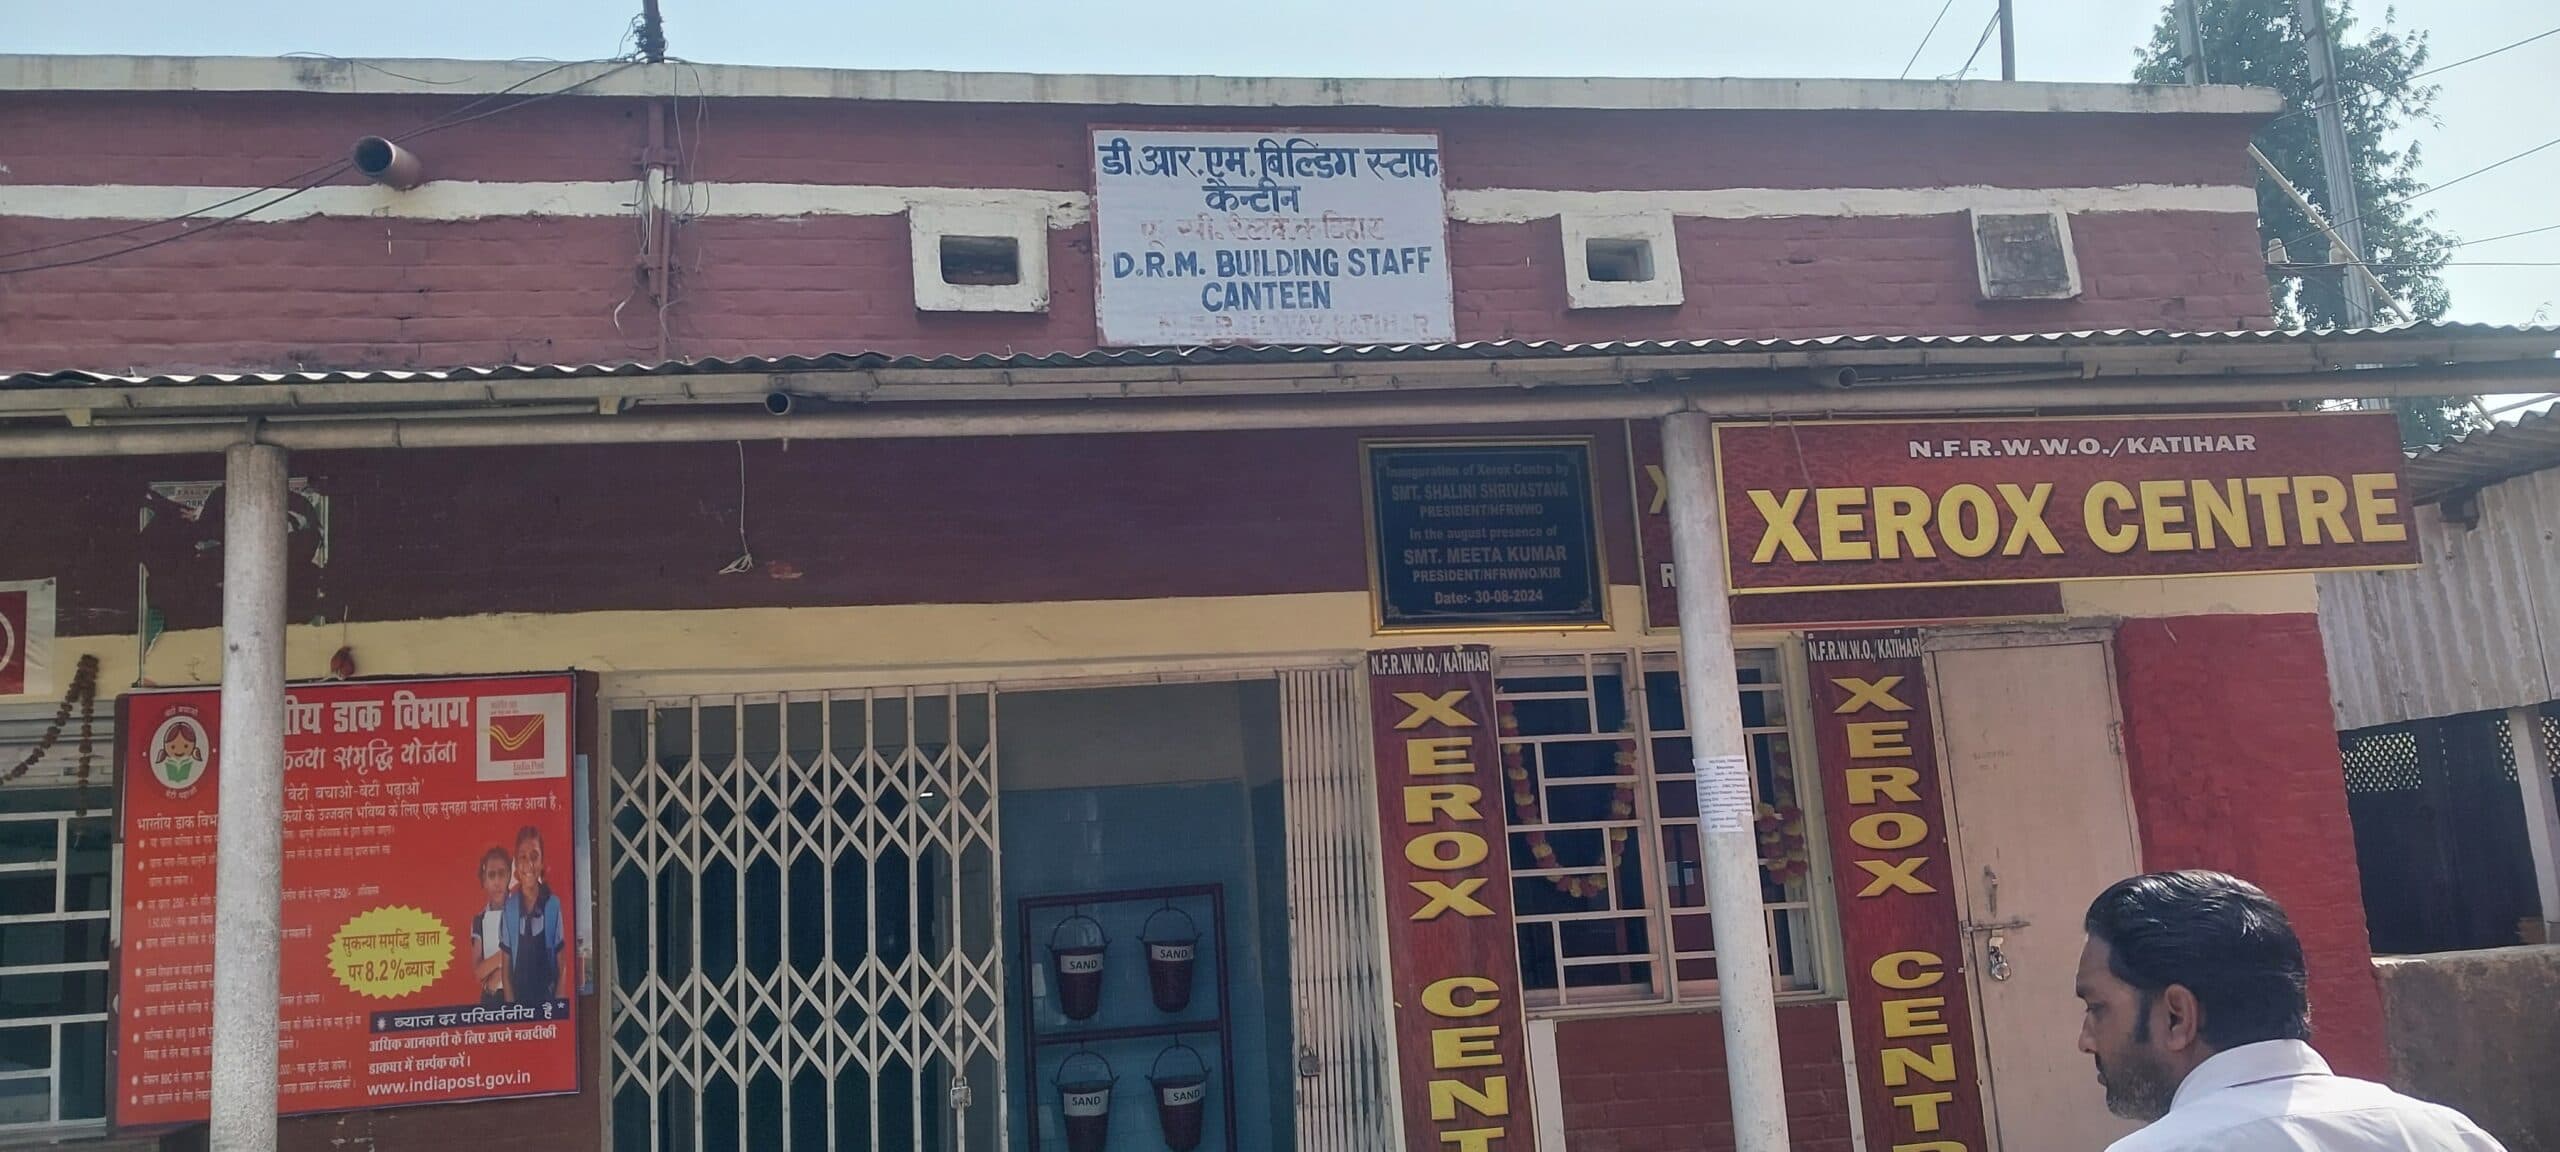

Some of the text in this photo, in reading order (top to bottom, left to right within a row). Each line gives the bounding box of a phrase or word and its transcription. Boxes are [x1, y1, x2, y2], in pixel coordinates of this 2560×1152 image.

[1364, 148, 1438, 180] स्टाफ
[1113, 246, 1432, 278] D.R.M. BUILDING STAFF
[1202, 281, 1331, 312] CANTEEN
[1909, 434, 2256, 458] N.F.R.W.W.O./KATIHAR
[1387, 463, 1569, 480] Inauguration of Xerox Centre by
[1391, 482, 1568, 501] SMT. SHALINI SHRIVASTAVA
[1746, 482, 2064, 564] XEROX
[2083, 472, 2407, 554] CENTRE
[1410, 526, 1557, 542] In the august presence of
[1404, 546, 1567, 565] SMT. MEETA KUMAR
[1475, 590, 1543, 602] 30-08-2024
[1371, 651, 1490, 676] N.F.R.W.W.O./KATIHAR
[331, 700, 384, 733] डाक
[392, 690, 469, 730] विभाग
[401, 737, 457, 764] योजना
[1830, 676, 1938, 897] XEROX
[137, 813, 171, 830] भारतीय
[175, 814, 194, 829] डाक
[401, 800, 419, 819] लिए
[422, 803, 438, 819] एक
[469, 795, 498, 813] योजना
[1392, 690, 1496, 920] XEROX
[342, 935, 376, 957] सुकन्या
[416, 931, 440, 946] खाता
[1160, 949, 1188, 959] SAND
[1070, 960, 1097, 970] SAND
[394, 1014, 434, 1028] ब्याज
[439, 1013, 456, 1026] दर
[461, 1004, 535, 1024] परिवर्तनीय
[369, 1024, 556, 1052] अधिक जानकारी के लिए अपने नजदीकी
[404, 1056, 414, 1071] में
[367, 1071, 530, 1095] www.indiapost.gov.in
[1173, 1089, 1200, 1101] SAND
[1072, 1097, 1100, 1107] SAND
